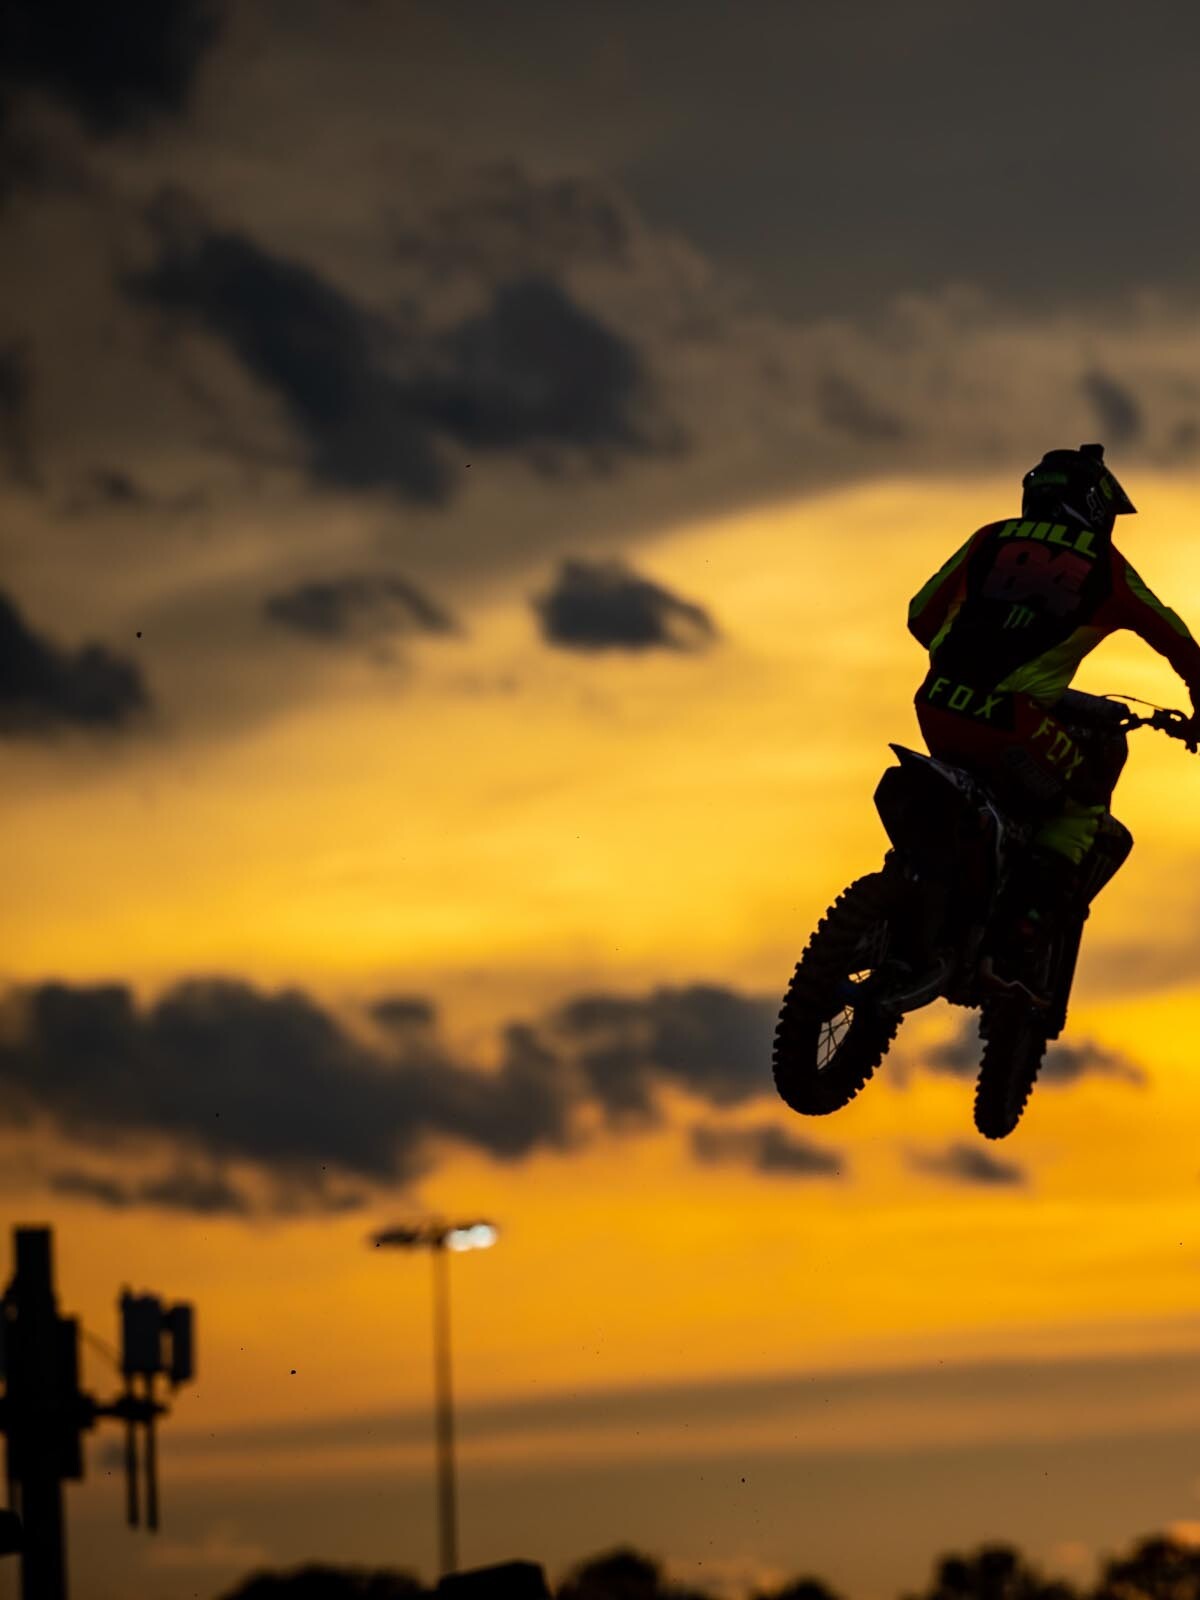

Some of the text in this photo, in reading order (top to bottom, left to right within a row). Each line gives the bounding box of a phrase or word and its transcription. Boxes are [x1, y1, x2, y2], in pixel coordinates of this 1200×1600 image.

[997, 519, 1098, 559] HILL
[927, 676, 1005, 719] FOX
[1030, 715, 1086, 781] FOX
